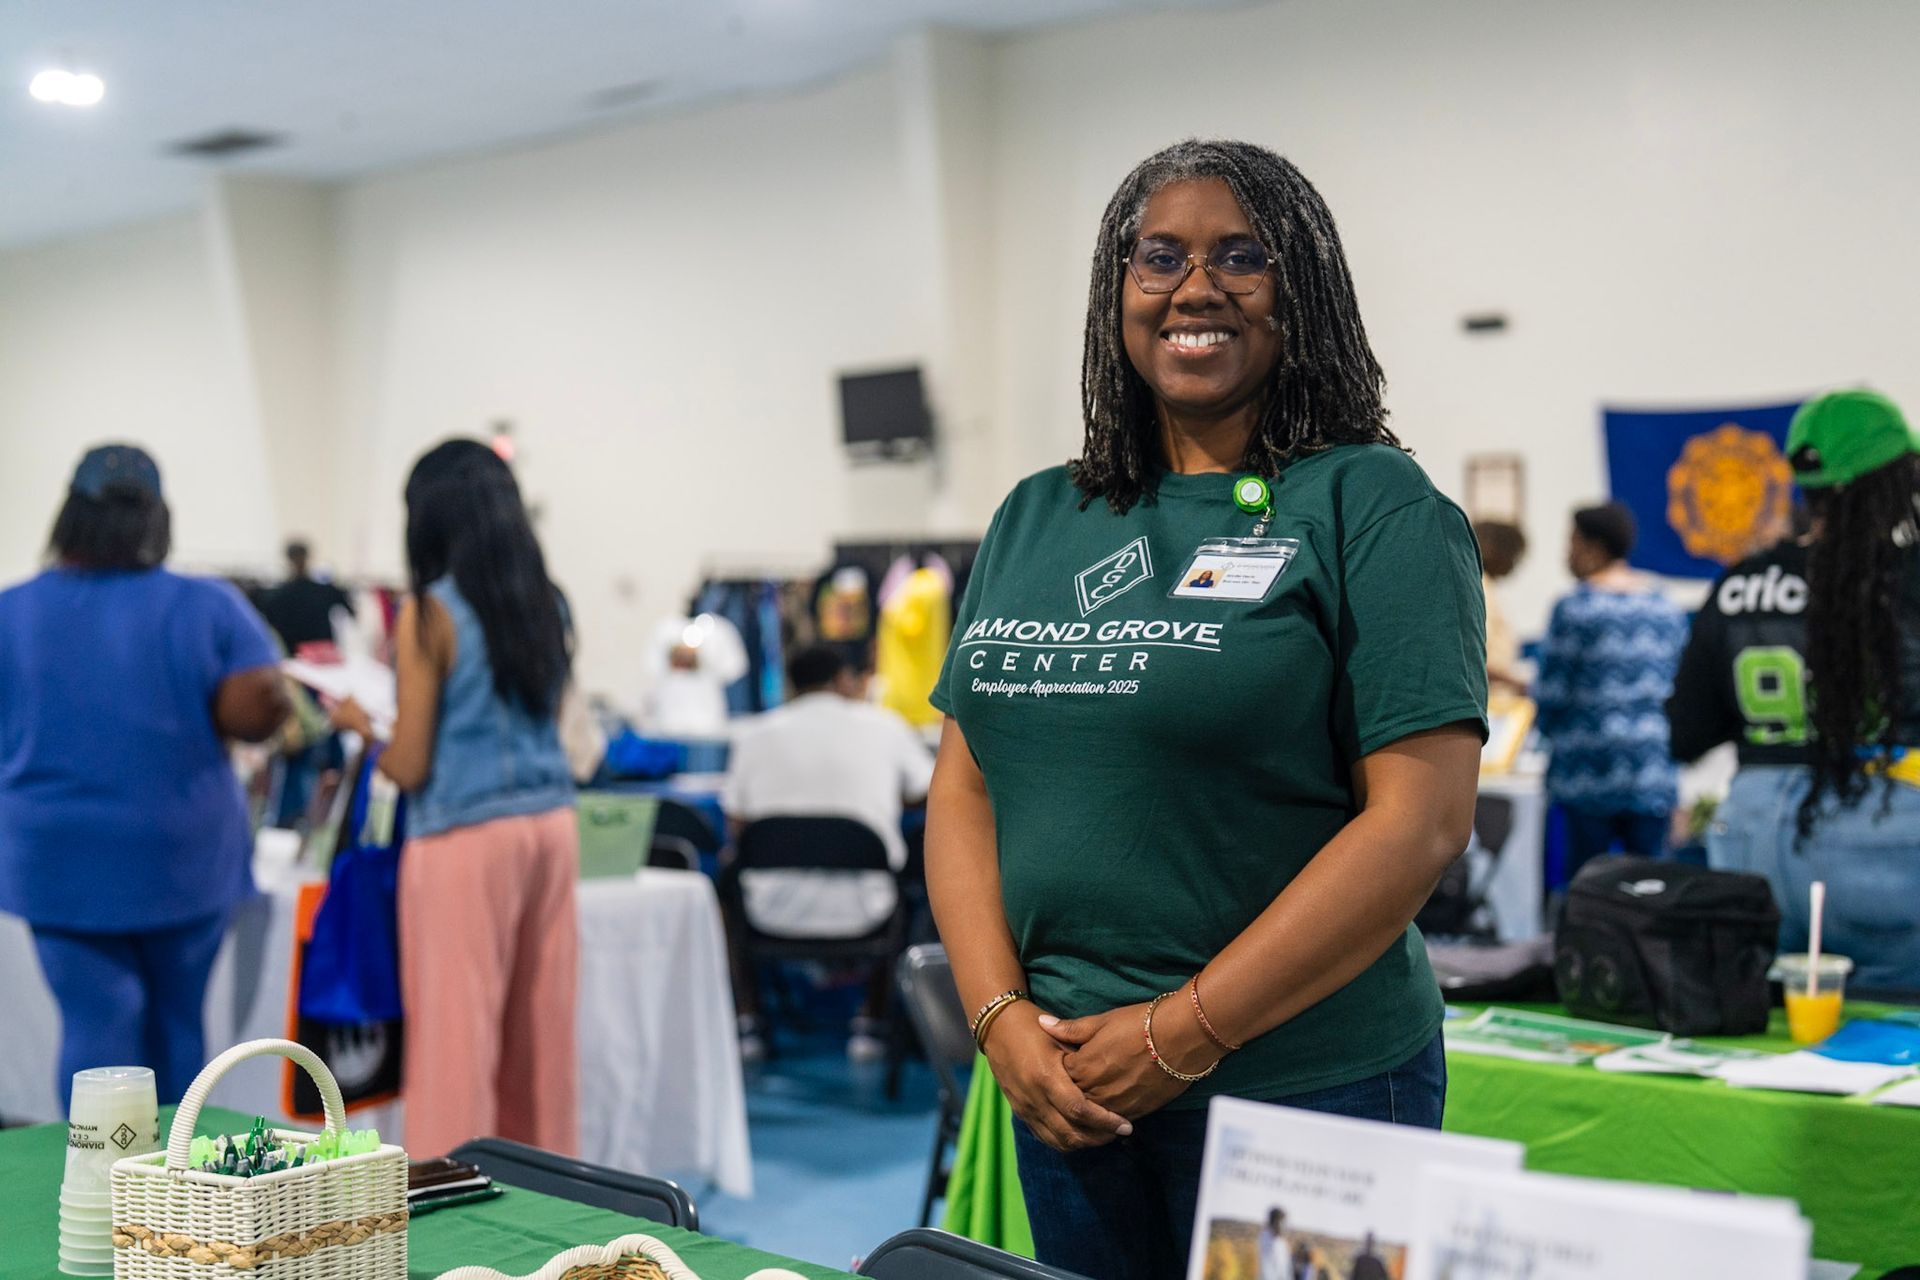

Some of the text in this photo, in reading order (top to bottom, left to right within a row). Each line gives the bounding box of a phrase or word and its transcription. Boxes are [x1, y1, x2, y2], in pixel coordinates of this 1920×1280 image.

[1090, 552, 1137, 599] DGC
[961, 618, 1224, 645] IAMOND GROVE
[970, 650, 1149, 672] CENTER
[971, 678, 1140, 698] Employee Appreciation 2025
